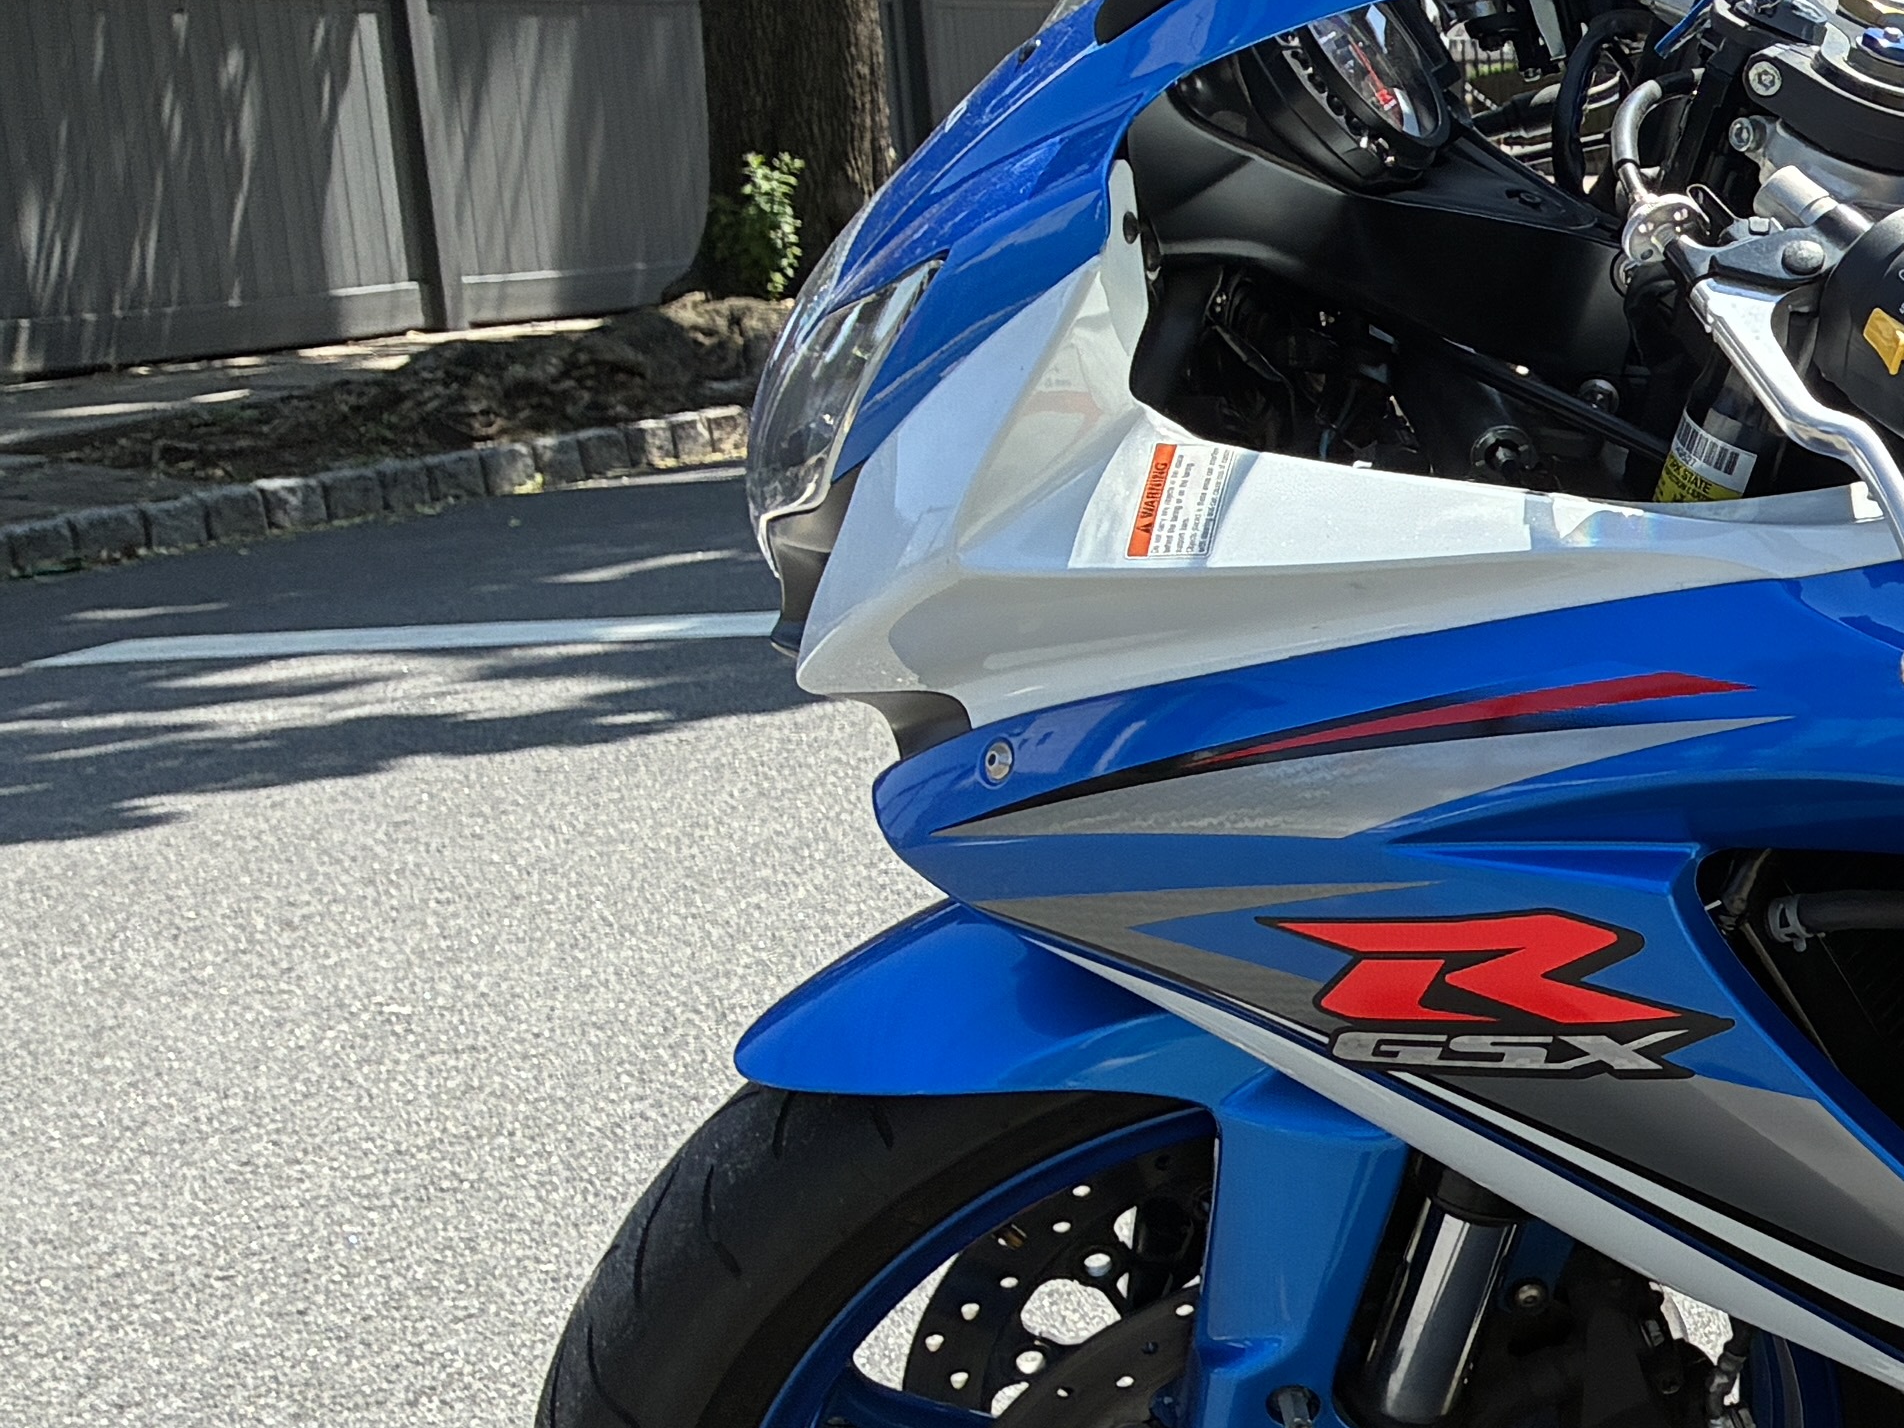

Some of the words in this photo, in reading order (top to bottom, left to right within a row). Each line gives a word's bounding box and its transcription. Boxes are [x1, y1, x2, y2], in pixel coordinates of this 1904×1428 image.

[1139, 461, 1168, 518] WARNING
[1681, 468, 1713, 494] STATE
[1332, 1029, 1690, 1071] GSX
